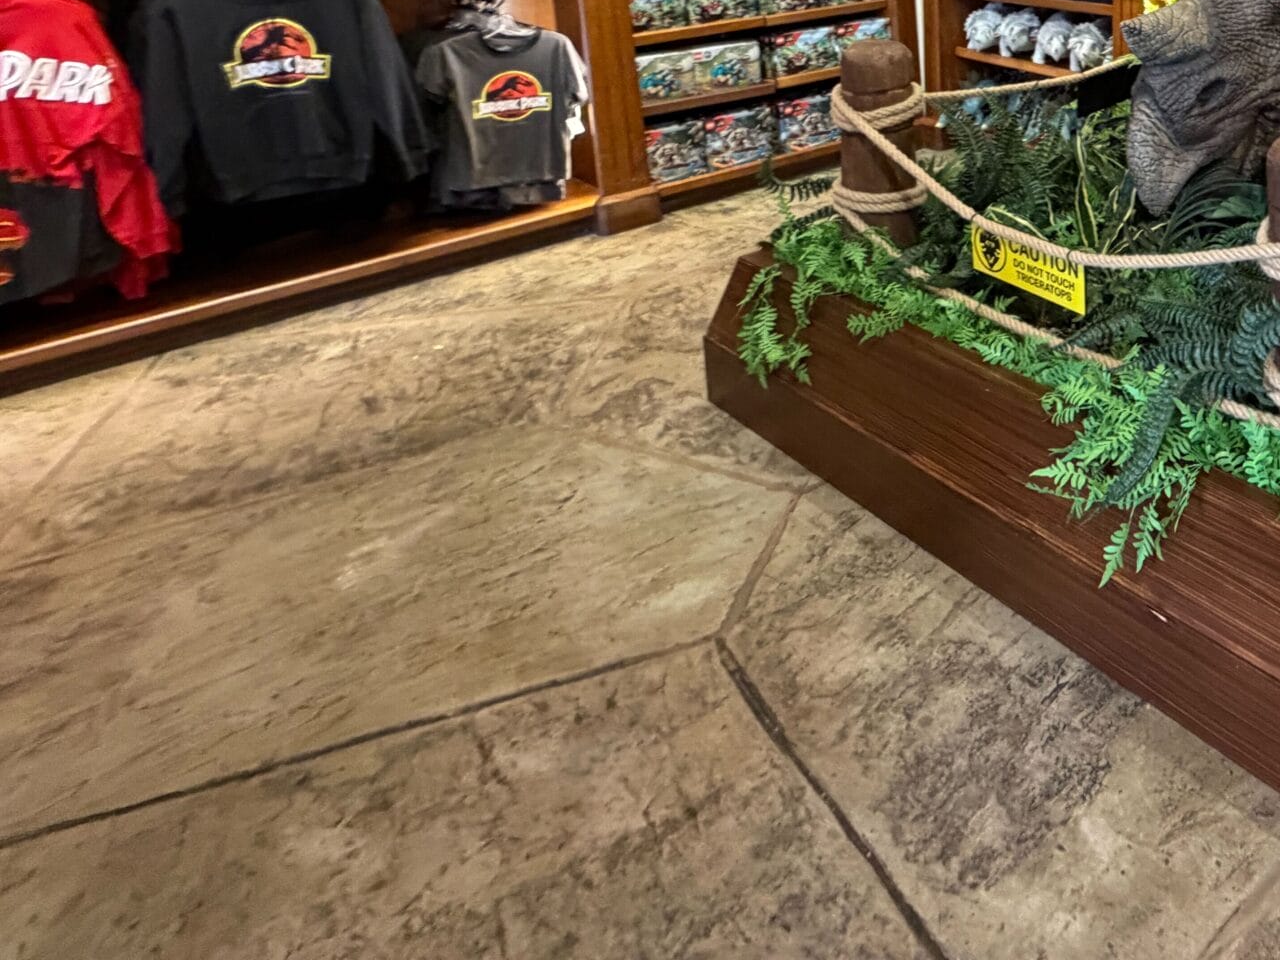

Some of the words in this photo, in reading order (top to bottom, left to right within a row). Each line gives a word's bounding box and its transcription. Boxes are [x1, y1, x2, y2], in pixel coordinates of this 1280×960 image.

[0, 50, 114, 106] PARK
[1008, 239, 1079, 278] CAUTION
[1013, 258, 1026, 271] DO
[1027, 262, 1043, 278] NOT
[1044, 269, 1075, 292] TOUCH
[1015, 270, 1072, 302] TRICERATOPS
